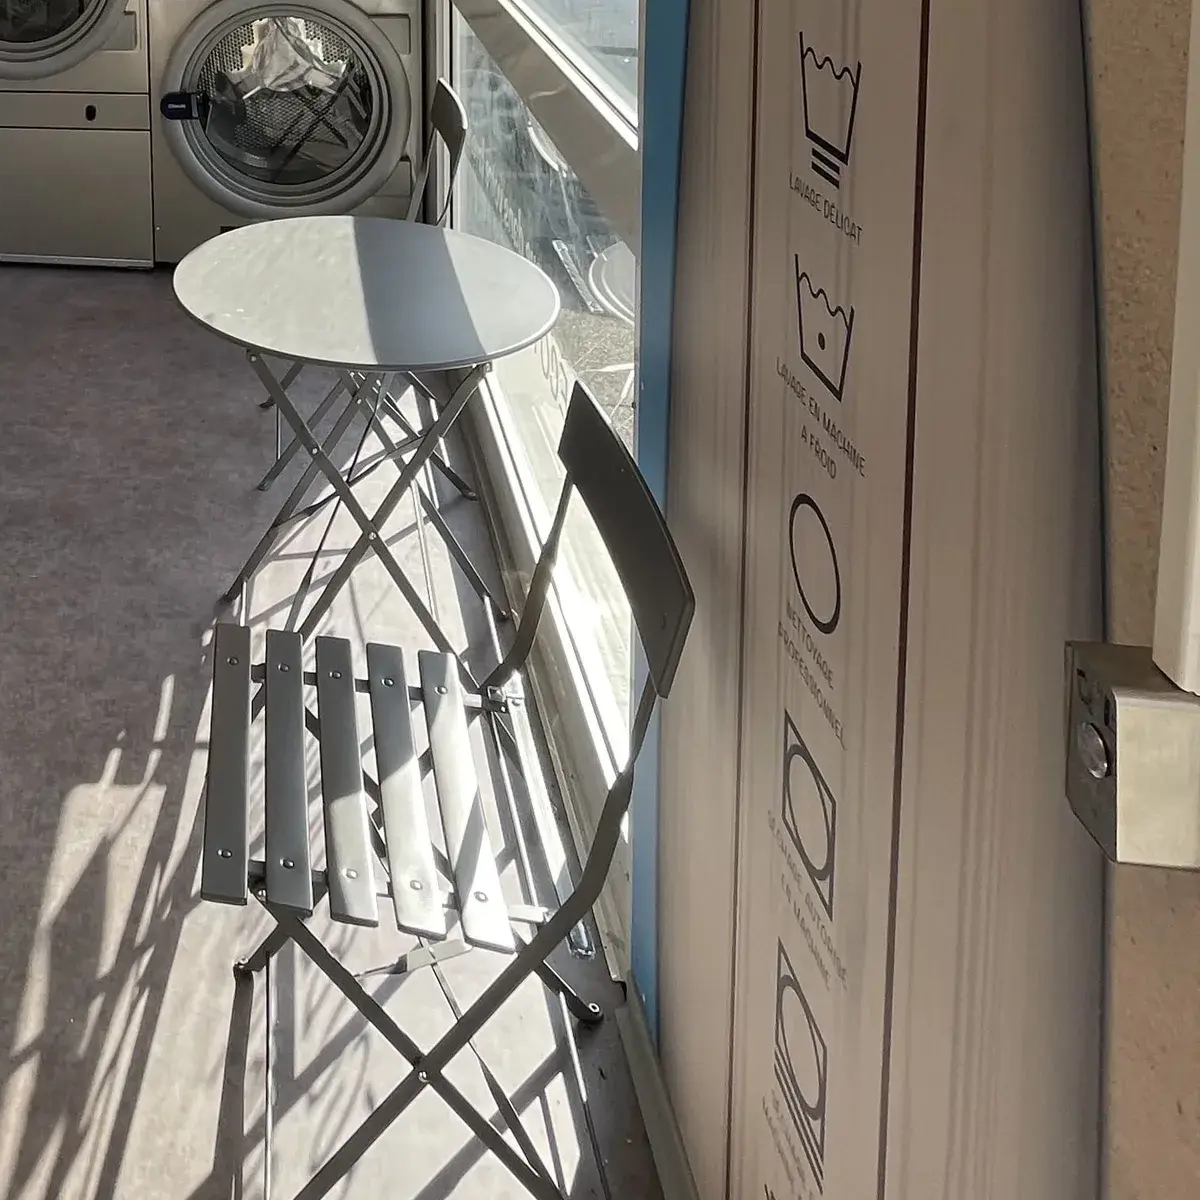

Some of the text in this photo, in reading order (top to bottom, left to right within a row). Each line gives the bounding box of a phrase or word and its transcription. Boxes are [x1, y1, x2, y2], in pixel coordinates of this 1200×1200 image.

[789, 172, 862, 246] LAVAGE DÉLICAT
[776, 356, 866, 477] LAVAGE EN MACHINE
[810, 433, 837, 480] FROID
